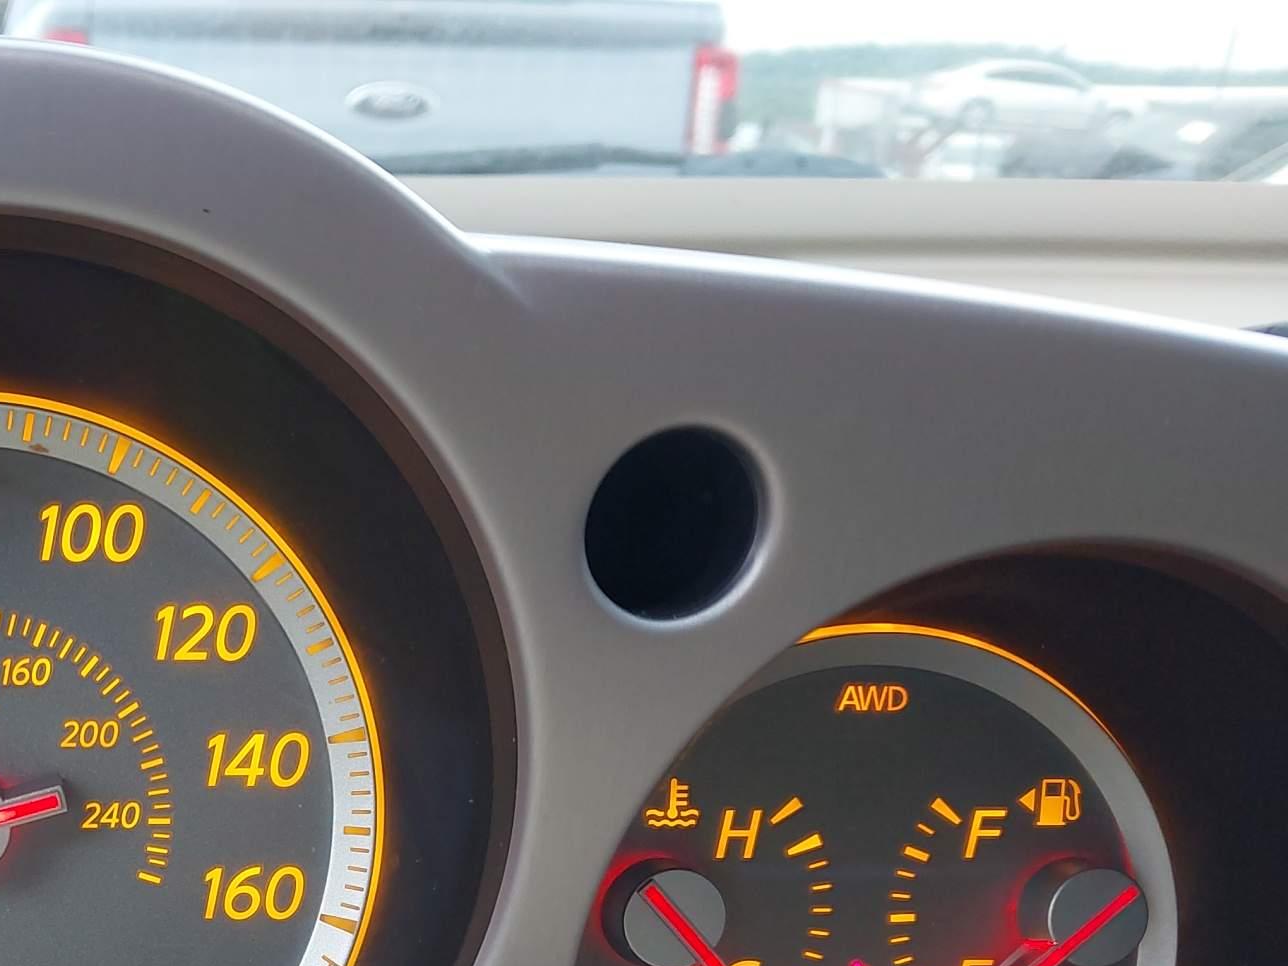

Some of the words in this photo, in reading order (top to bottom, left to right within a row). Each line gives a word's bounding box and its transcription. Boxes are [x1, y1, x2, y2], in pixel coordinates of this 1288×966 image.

[39, 502, 146, 565] 100
[154, 602, 259, 663] 120
[1, 655, 53, 687] 160
[838, 685, 909, 712] AWD
[60, 721, 121, 749] 200
[206, 730, 312, 790] 140
[81, 801, 142, 830] 240
[715, 809, 763, 860] H
[964, 809, 1009, 859] F
[203, 863, 307, 921] 160
